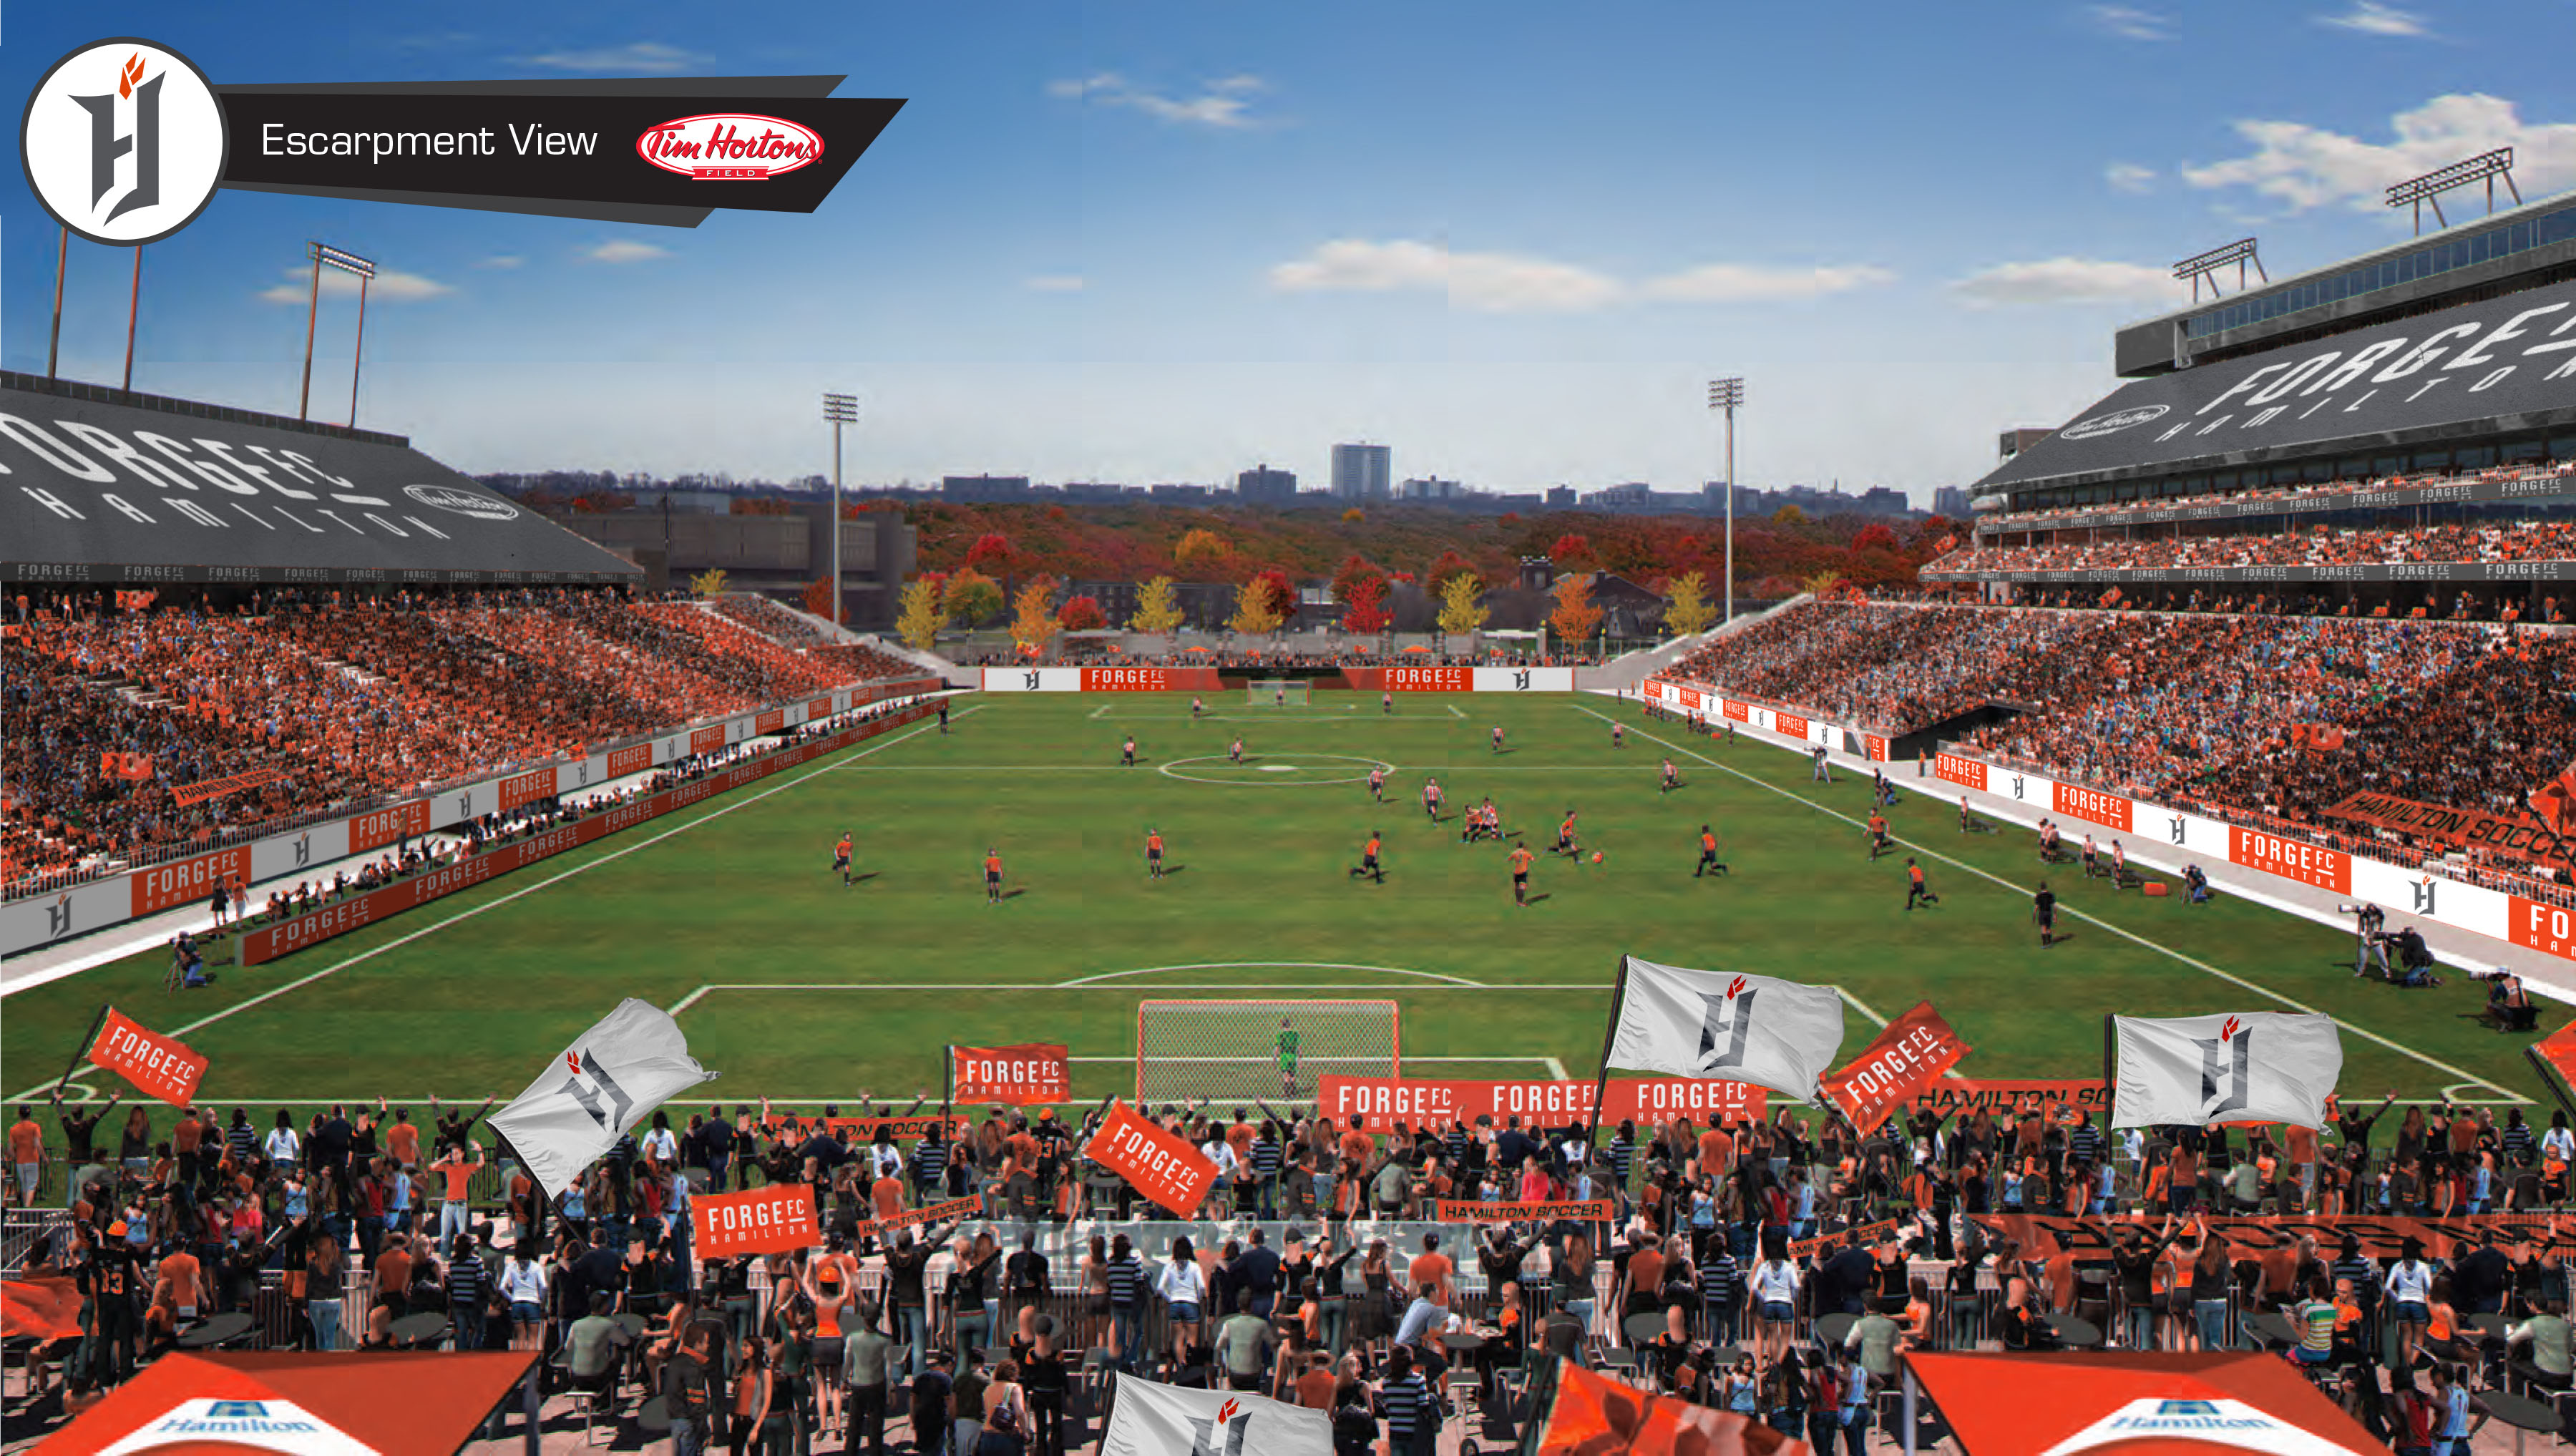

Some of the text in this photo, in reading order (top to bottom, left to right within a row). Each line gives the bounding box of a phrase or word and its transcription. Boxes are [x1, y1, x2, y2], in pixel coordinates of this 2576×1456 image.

[2196, 301, 2571, 415] FORGE
[0, 413, 354, 500] ORGE FC
[2421, 486, 2472, 499] FORGE FC
[2502, 478, 2561, 493] FORGE FC
[2238, 503, 2265, 512] FORGE
[2290, 499, 2321, 509] FORGE
[2353, 493, 2387, 504] FORGE
[20, 486, 451, 540] HAMILTON
[2147, 510, 2169, 519] FORGE
[2188, 507, 2212, 515] FORGE
[18, 565, 73, 575] FORGE
[125, 566, 170, 577] FORGE
[209, 567, 248, 577] FORGE
[285, 568, 318, 577] FORGE
[346, 570, 376, 578] FORGE
[404, 570, 431, 579] FORGE
[2243, 568, 2275, 577] FORGE
[2313, 567, 2351, 576] FORGE
[2389, 565, 2435, 575] FORGE
[2486, 563, 2557, 575] FORGE FC
[1091, 670, 1165, 683] FORGE FC
[1385, 669, 1461, 683] FORGE FC
[1725, 700, 1740, 714] FORGE
[1779, 714, 1804, 728] FORGE FC
[694, 729, 715, 746] FORGE
[1873, 738, 1880, 748] FC
[613, 750, 639, 768] FORGE
[774, 754, 796, 767] FORGE
[1938, 754, 1981, 776] FORGE FC
[506, 771, 551, 796] FORGE FC
[729, 767, 754, 783] FORGE
[671, 780, 711, 803] FORGE FC
[2062, 786, 2122, 814] FORGE FC
[359, 804, 421, 839] FORG FC
[605, 801, 653, 827] FORGE FC
[2062, 804, 2122, 829] HAMILTON
[2341, 794, 2469, 833] HAMILTON
[519, 826, 577, 858] FORGE FC
[2242, 831, 2335, 870] FORGE FC
[147, 851, 238, 897] FORGE FC
[415, 857, 489, 895] FORGE FC
[2242, 854, 2335, 889] HAMILTON
[271, 899, 369, 947] FORGE FC
[271, 914, 370, 956] HAMILTON
[109, 1025, 195, 1082] FORGE FC
[103, 1047, 185, 1096] HAMILTON
[967, 1060, 1060, 1083] FORGE FC
[1845, 1025, 1933, 1105] FORGE FC
[967, 1084, 1060, 1095] HAMILTON
[1862, 1045, 1949, 1115] HAMILTON
[1339, 1085, 1451, 1114] FORGE FC
[1493, 1085, 1578, 1113] FORGE
[1638, 1083, 1747, 1109] FORGE FC
[1918, 1088, 2067, 1108] HAMILTON
[1113, 1123, 1199, 1188] FORGE FC
[1106, 1143, 1186, 1203] HAMILTON
[707, 1197, 805, 1233] FORGE FC
[1445, 1203, 1603, 1218] HAMILTON SOCCER
[710, 1223, 808, 1246] HAMILTON
[157, 1418, 319, 1432] Hamilton
